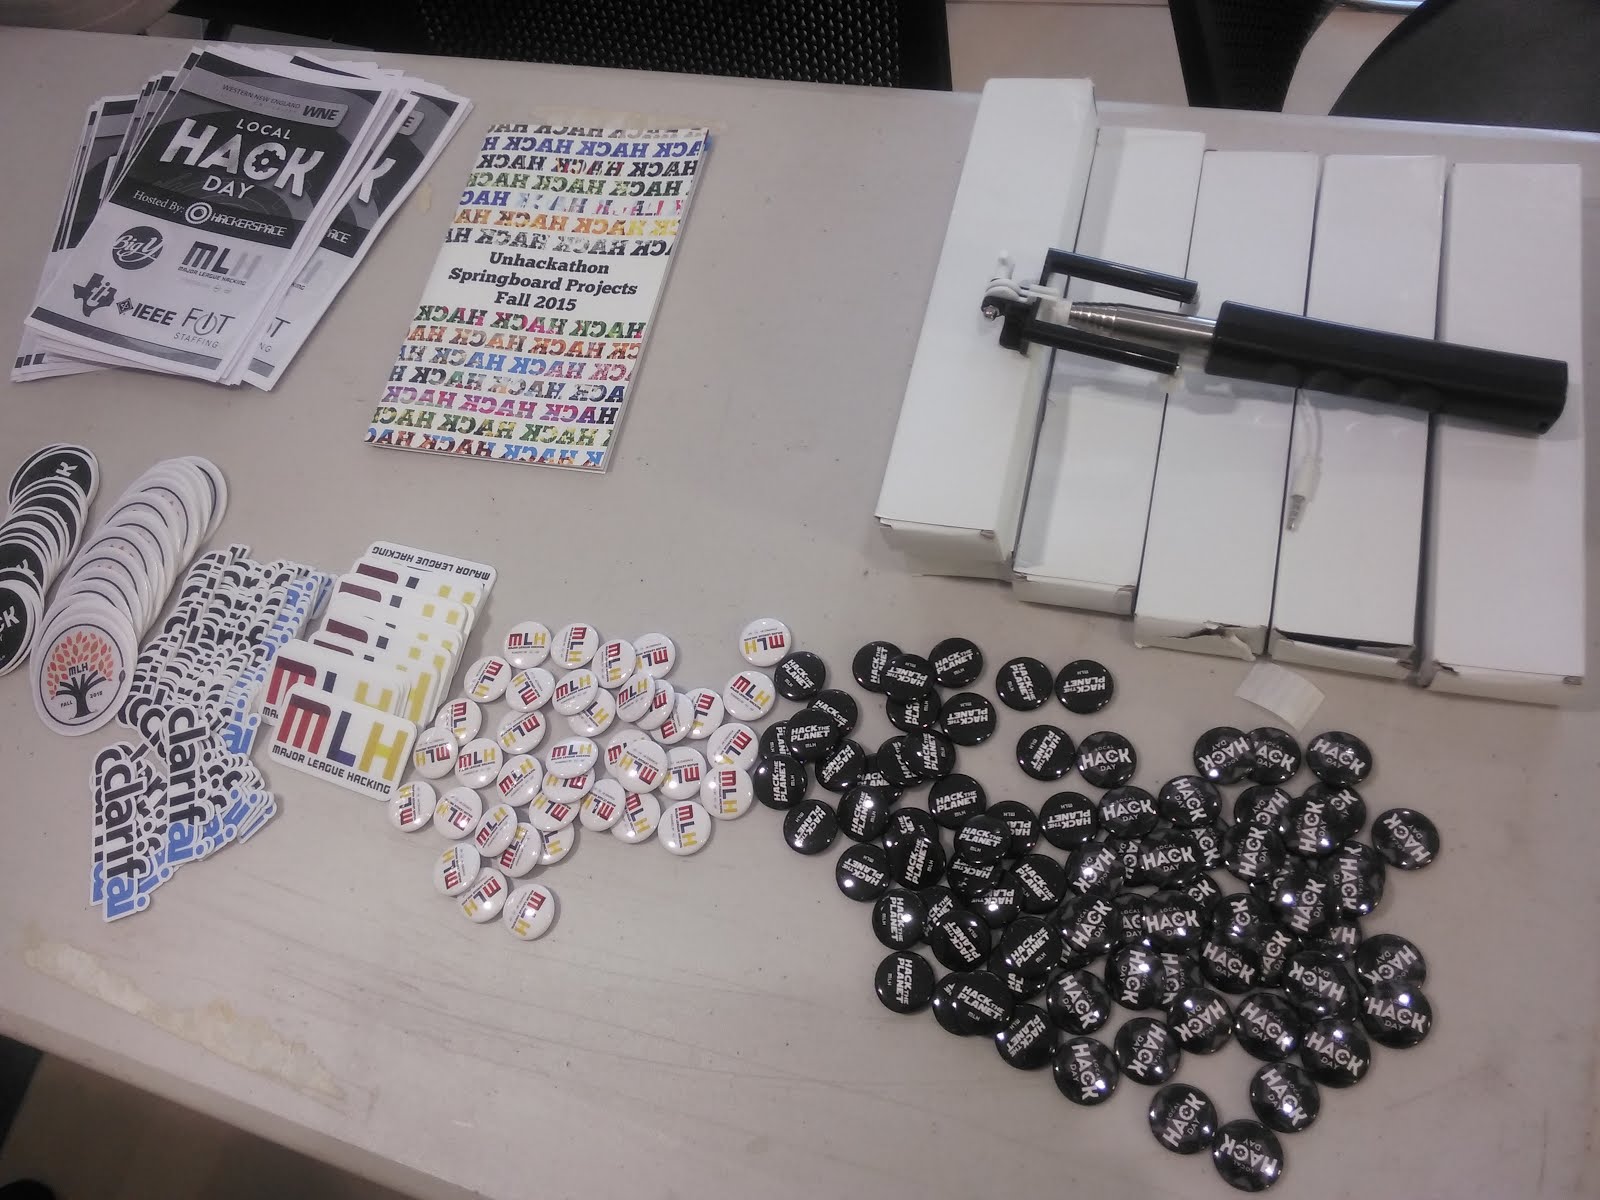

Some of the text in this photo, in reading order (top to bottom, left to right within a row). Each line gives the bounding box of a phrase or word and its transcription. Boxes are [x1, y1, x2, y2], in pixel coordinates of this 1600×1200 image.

[222, 84, 253, 99] WESTERN
[253, 94, 270, 103] NEW
[270, 98, 301, 109] ENGLAND
[302, 105, 339, 120] WNE
[236, 118, 291, 140] LOCAL
[159, 117, 325, 197] HACK
[202, 175, 254, 199] DAY
[133, 190, 168, 209] Hosted
[211, 212, 288, 237] HACKERSPACE
[178, 266, 198, 275] MAJOR
[199, 271, 221, 281] LEAGUE
[489, 251, 611, 275] Unhackathon
[448, 267, 639, 297] Springboard Projects
[132, 302, 177, 326] IEEE
[494, 291, 578, 312] Fall 2015
[173, 332, 220, 349] STAFFING
[371, 546, 491, 580] MAJOR LEAGUE HACKING
[508, 632, 546, 646] MLH
[568, 627, 587, 663] MLH
[744, 634, 785, 655] MLH
[69, 662, 89, 676] MLH
[607, 642, 622, 682] MLH
[787, 659, 810, 683] HACK
[935, 651, 961, 669] HACK
[936, 654, 974, 675] PLANET
[1017, 663, 1033, 689] HACK
[474, 661, 503, 697] MLH
[555, 675, 591, 699] MLH
[618, 679, 649, 704] MLH
[732, 675, 772, 708] MLH
[782, 664, 812, 690] PLANET
[1010, 664, 1032, 701] PLANET
[1064, 676, 1106, 688] PLANET
[1077, 682, 1106, 694] HACK
[791, 724, 818, 735] HACK
[947, 708, 988, 720] PLANET
[960, 714, 988, 726] HACK
[276, 693, 409, 781] MLH
[501, 714, 540, 747] MLH
[790, 730, 831, 742] PLANET
[416, 746, 450, 767] MLH
[458, 747, 496, 768] MLH
[552, 744, 592, 758] MLH
[1030, 731, 1055, 770] PLANET
[1043, 735, 1061, 762] HACK
[1081, 748, 1133, 770] HACK
[1199, 737, 1250, 771] HACK
[1313, 738, 1365, 775] HACK
[272, 744, 391, 794] MAJOR LEAGUE HACKING
[499, 758, 534, 794] MLH
[619, 752, 658, 785] MLH
[779, 760, 789, 802] PLANET
[167, 707, 207, 863] clarifai
[721, 770, 738, 814] MLH
[772, 769, 781, 802] HACK
[935, 791, 965, 806] HACK
[1172, 778, 1207, 822] HACK
[400, 785, 413, 825] MLH
[626, 793, 650, 834] MLH
[936, 796, 977, 813] PLANET
[1047, 809, 1091, 824] PLANET
[1102, 799, 1153, 821] HACK
[476, 806, 507, 845] MLH
[678, 804, 698, 848] MLH
[962, 827, 990, 840] HACK
[1061, 817, 1092, 830] HACK
[1383, 813, 1431, 863] HACK
[104, 763, 147, 918] clarifai
[500, 826, 526, 869] MLH
[958, 834, 1001, 848] PLANET
[1239, 827, 1268, 877] HACK
[442, 850, 459, 889] MLH
[844, 858, 885, 880] PLANET
[1142, 847, 1196, 870] HACK
[851, 868, 880, 886] HACK
[1015, 868, 1051, 902] PLANET
[1021, 863, 1046, 890] HACK
[463, 879, 501, 917] MLH
[1291, 878, 1327, 932] HACK
[1071, 900, 1113, 949] HACK
[1145, 910, 1200, 933] HACK
[1011, 934, 1037, 961] HACK
[1015, 931, 1050, 968] PLANET
[1202, 942, 1255, 985] HACK
[896, 957, 905, 1004] PLANET
[903, 958, 913, 990] HACK
[1288, 961, 1346, 1001] HACK
[1364, 945, 1418, 985] HACK
[957, 993, 1003, 1021] PLANET
[963, 985, 993, 1006] HACK
[1058, 975, 1097, 1029] HACK
[1174, 999, 1227, 1043] HACK
[1367, 997, 1427, 1034] HACK
[1006, 1014, 1041, 1053] PLANET
[1021, 1021, 1046, 1049] HACK
[1128, 1023, 1167, 1077] HACK
[1306, 1032, 1364, 1077] HACK
[1071, 1044, 1099, 1101] HACK
[1162, 1092, 1206, 1147] HACK
[1220, 1133, 1278, 1175] HACK
